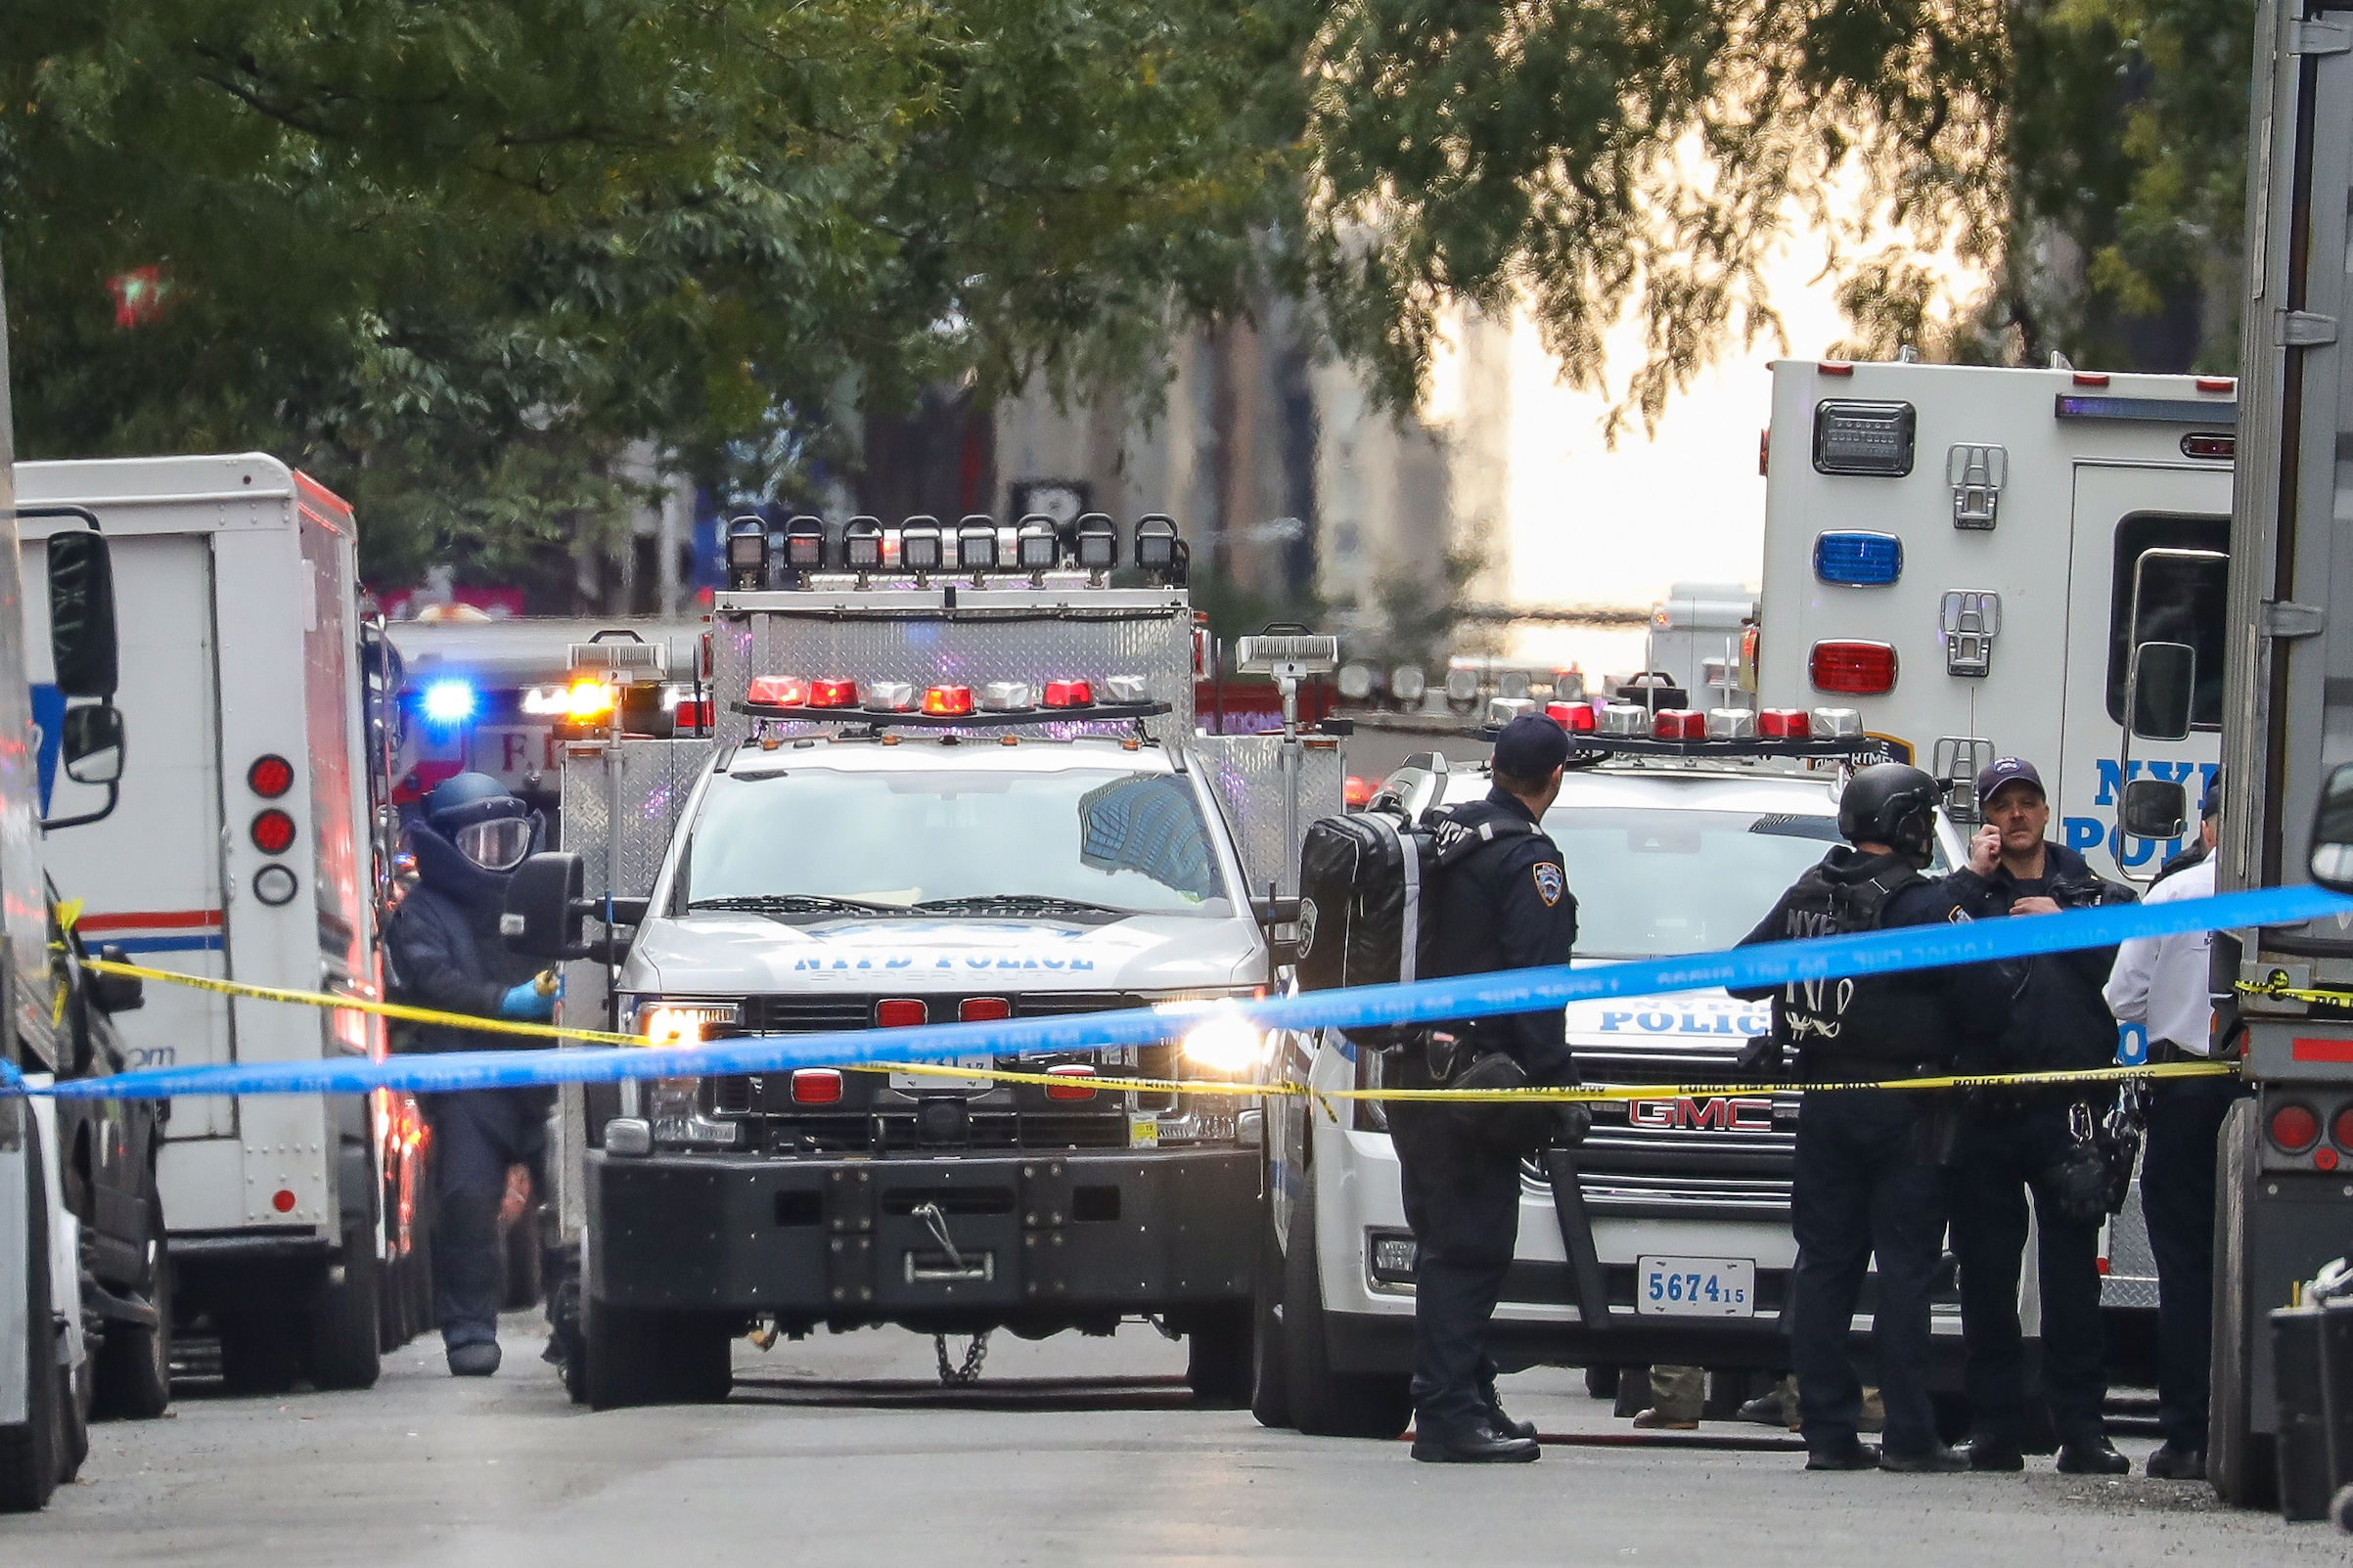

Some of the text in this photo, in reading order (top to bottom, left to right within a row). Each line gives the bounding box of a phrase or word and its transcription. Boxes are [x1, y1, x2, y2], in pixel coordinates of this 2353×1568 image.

[1600, 1010, 1770, 1036] POLIC
[1629, 1098, 1773, 1133] GMC
[1649, 1274, 1745, 1304] 5674 15
